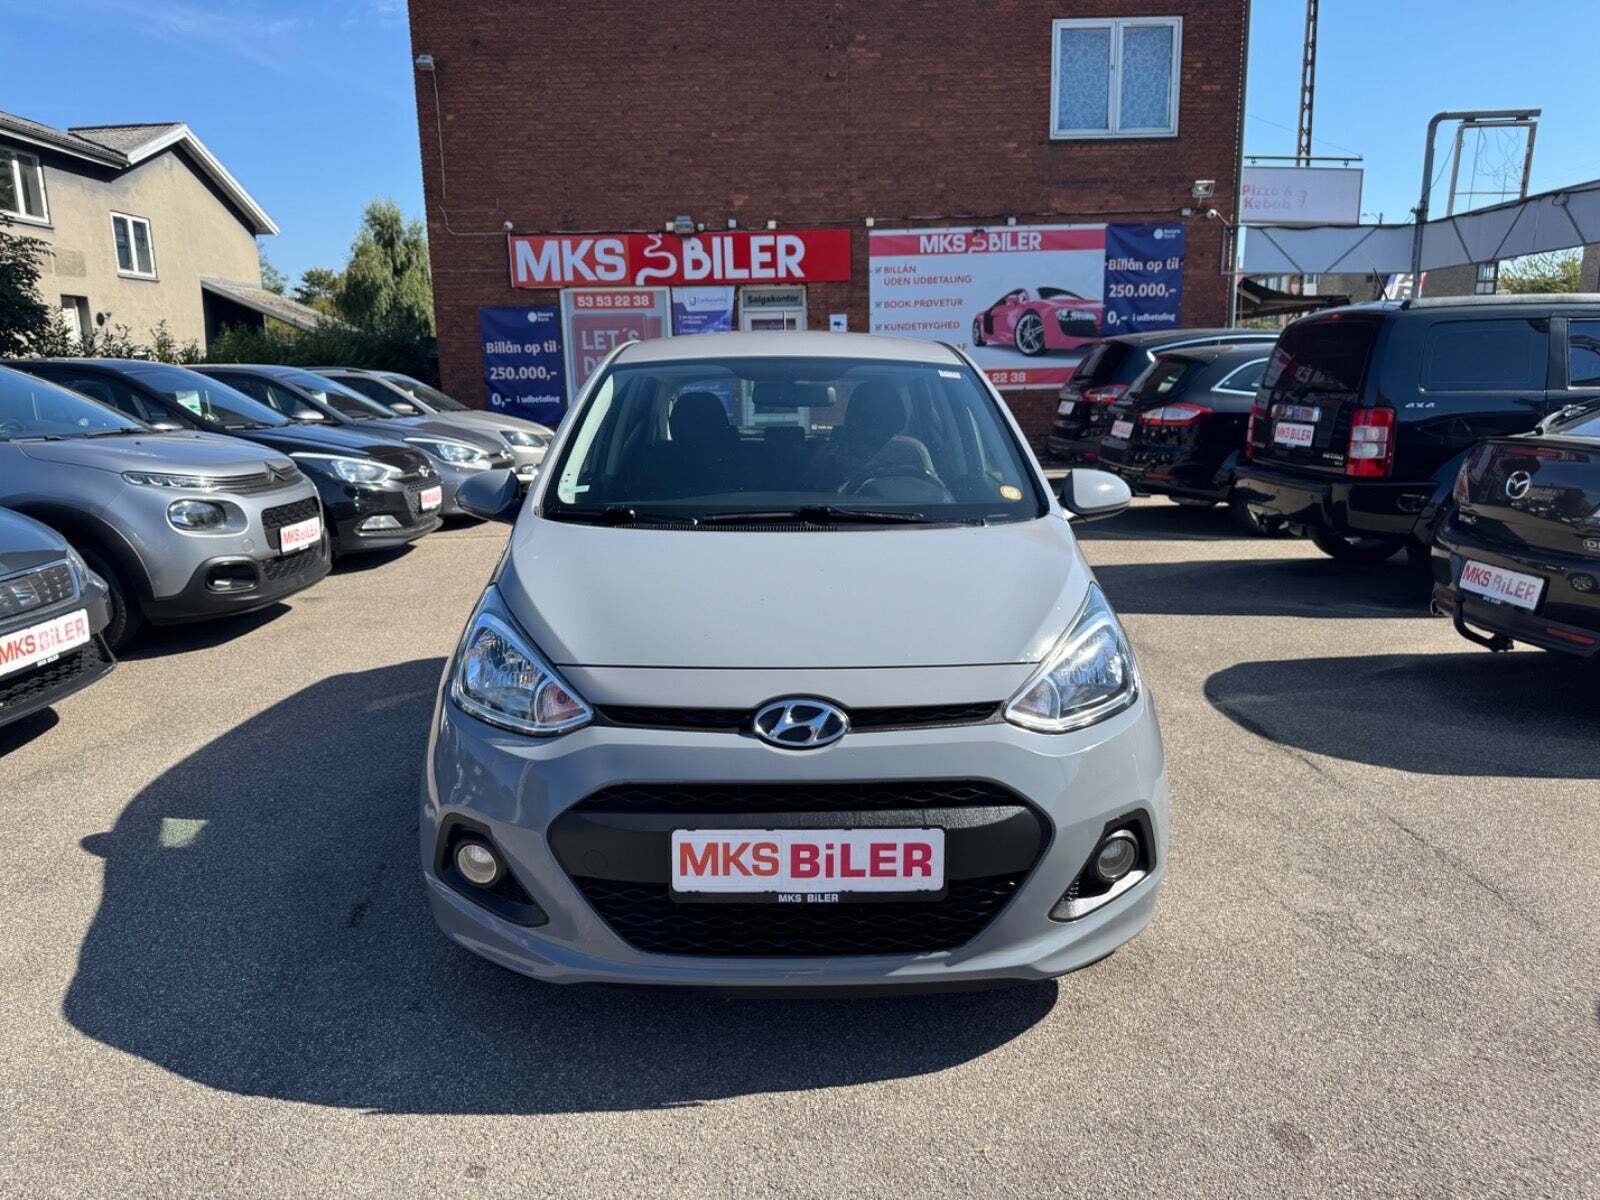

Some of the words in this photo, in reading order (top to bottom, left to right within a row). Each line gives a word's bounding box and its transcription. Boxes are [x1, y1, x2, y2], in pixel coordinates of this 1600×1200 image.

[920, 234, 966, 254] MKS
[988, 232, 1042, 252] BILER
[515, 238, 626, 282] MKS
[682, 235, 806, 280] BILER
[1108, 257, 1143, 271] Billån
[1146, 260, 1163, 273] op
[1166, 256, 1180, 270] til
[883, 277, 911, 286] UDEN
[913, 275, 972, 285] UDBETALING
[1109, 283, 1177, 298] 250.000,-
[577, 295, 593, 307] 53
[596, 295, 612, 307] 53
[614, 295, 630, 306] 22
[633, 295, 649, 306] 38
[883, 300, 912, 309] BOOK
[883, 321, 960, 332] KUNDETRYGHED
[486, 341, 521, 354] Billån
[524, 343, 541, 356] op
[543, 340, 557, 353] til
[490, 366, 558, 381] 250.000,-
[992, 372, 1008, 383] 22
[1010, 371, 1027, 383] 38
[1463, 564, 1492, 588] MKS
[0, 634, 36, 666] MKS
[679, 842, 780, 877] MKS
[790, 842, 932, 879] BiLER
[778, 894, 802, 903] MKS
